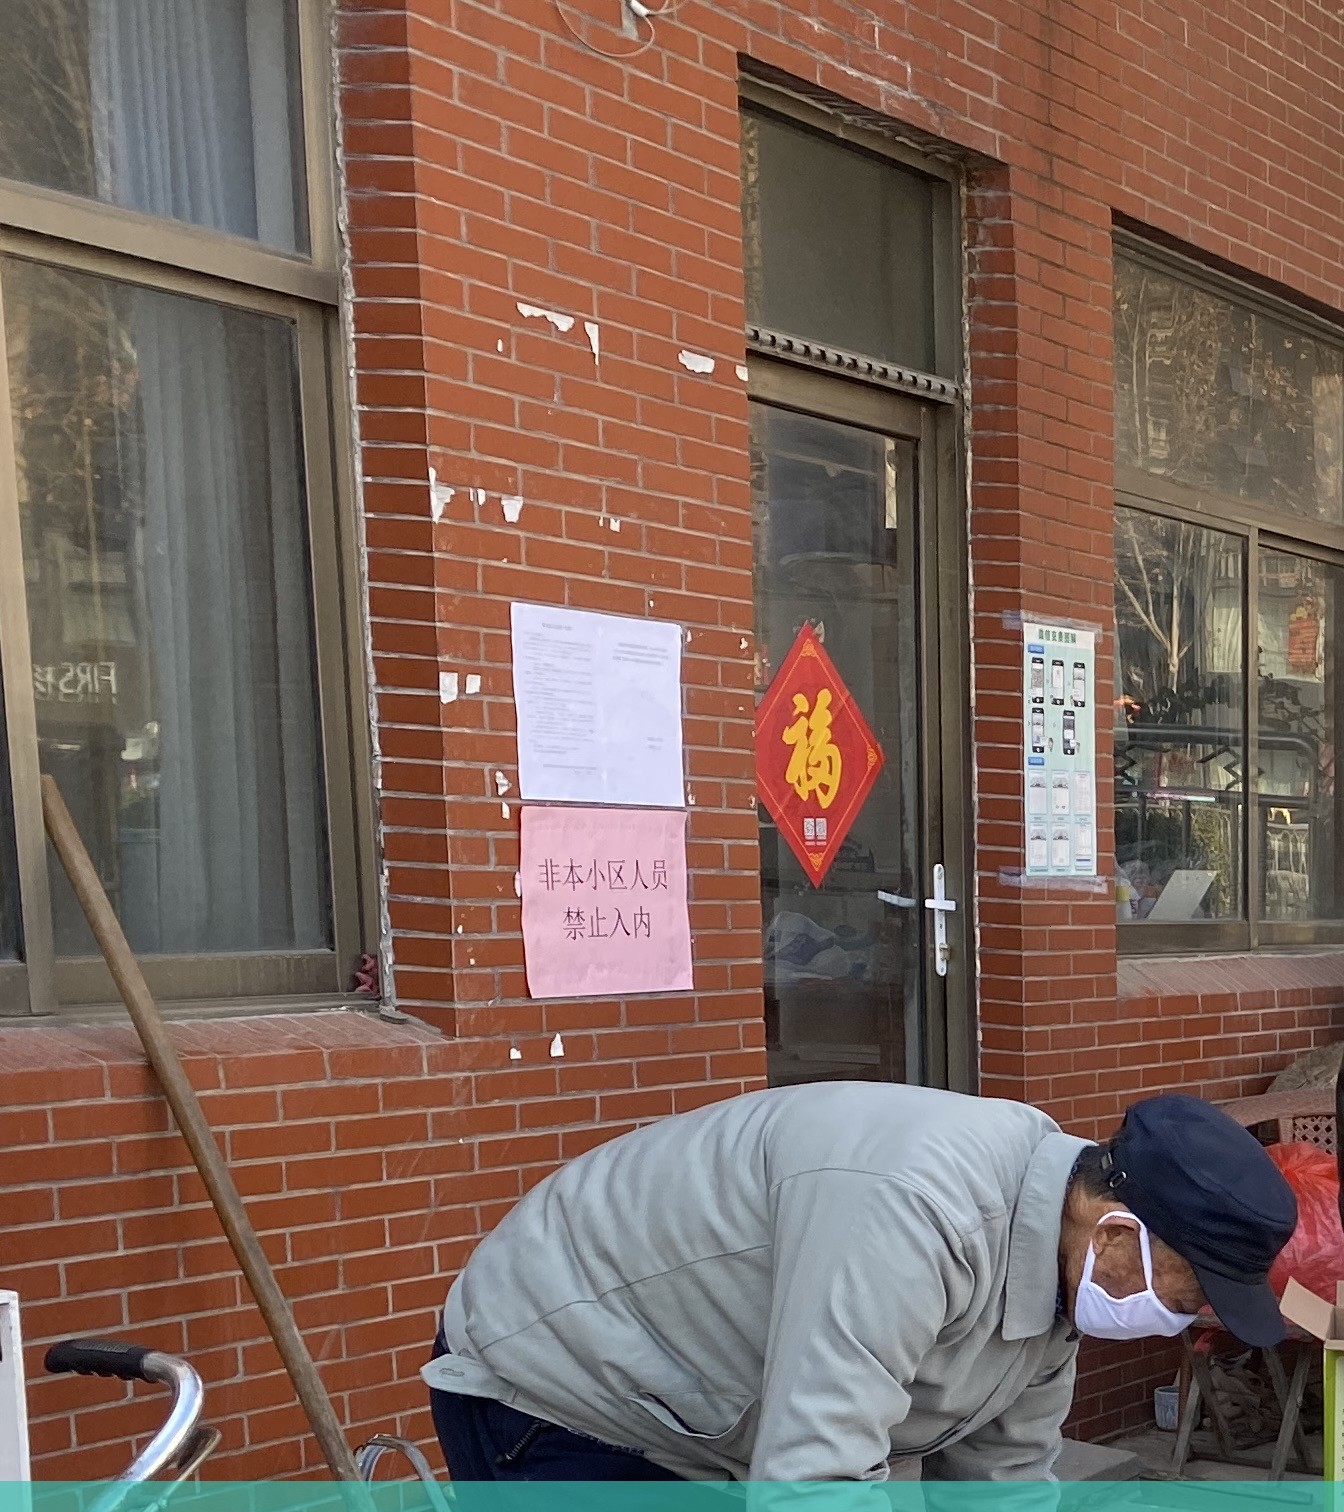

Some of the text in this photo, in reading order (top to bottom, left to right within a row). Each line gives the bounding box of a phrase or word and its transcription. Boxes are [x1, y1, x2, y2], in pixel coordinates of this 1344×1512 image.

[782, 687, 843, 809] 福
[537, 858, 668, 891] 非本小区人员
[562, 906, 651, 940] 禁止入内
